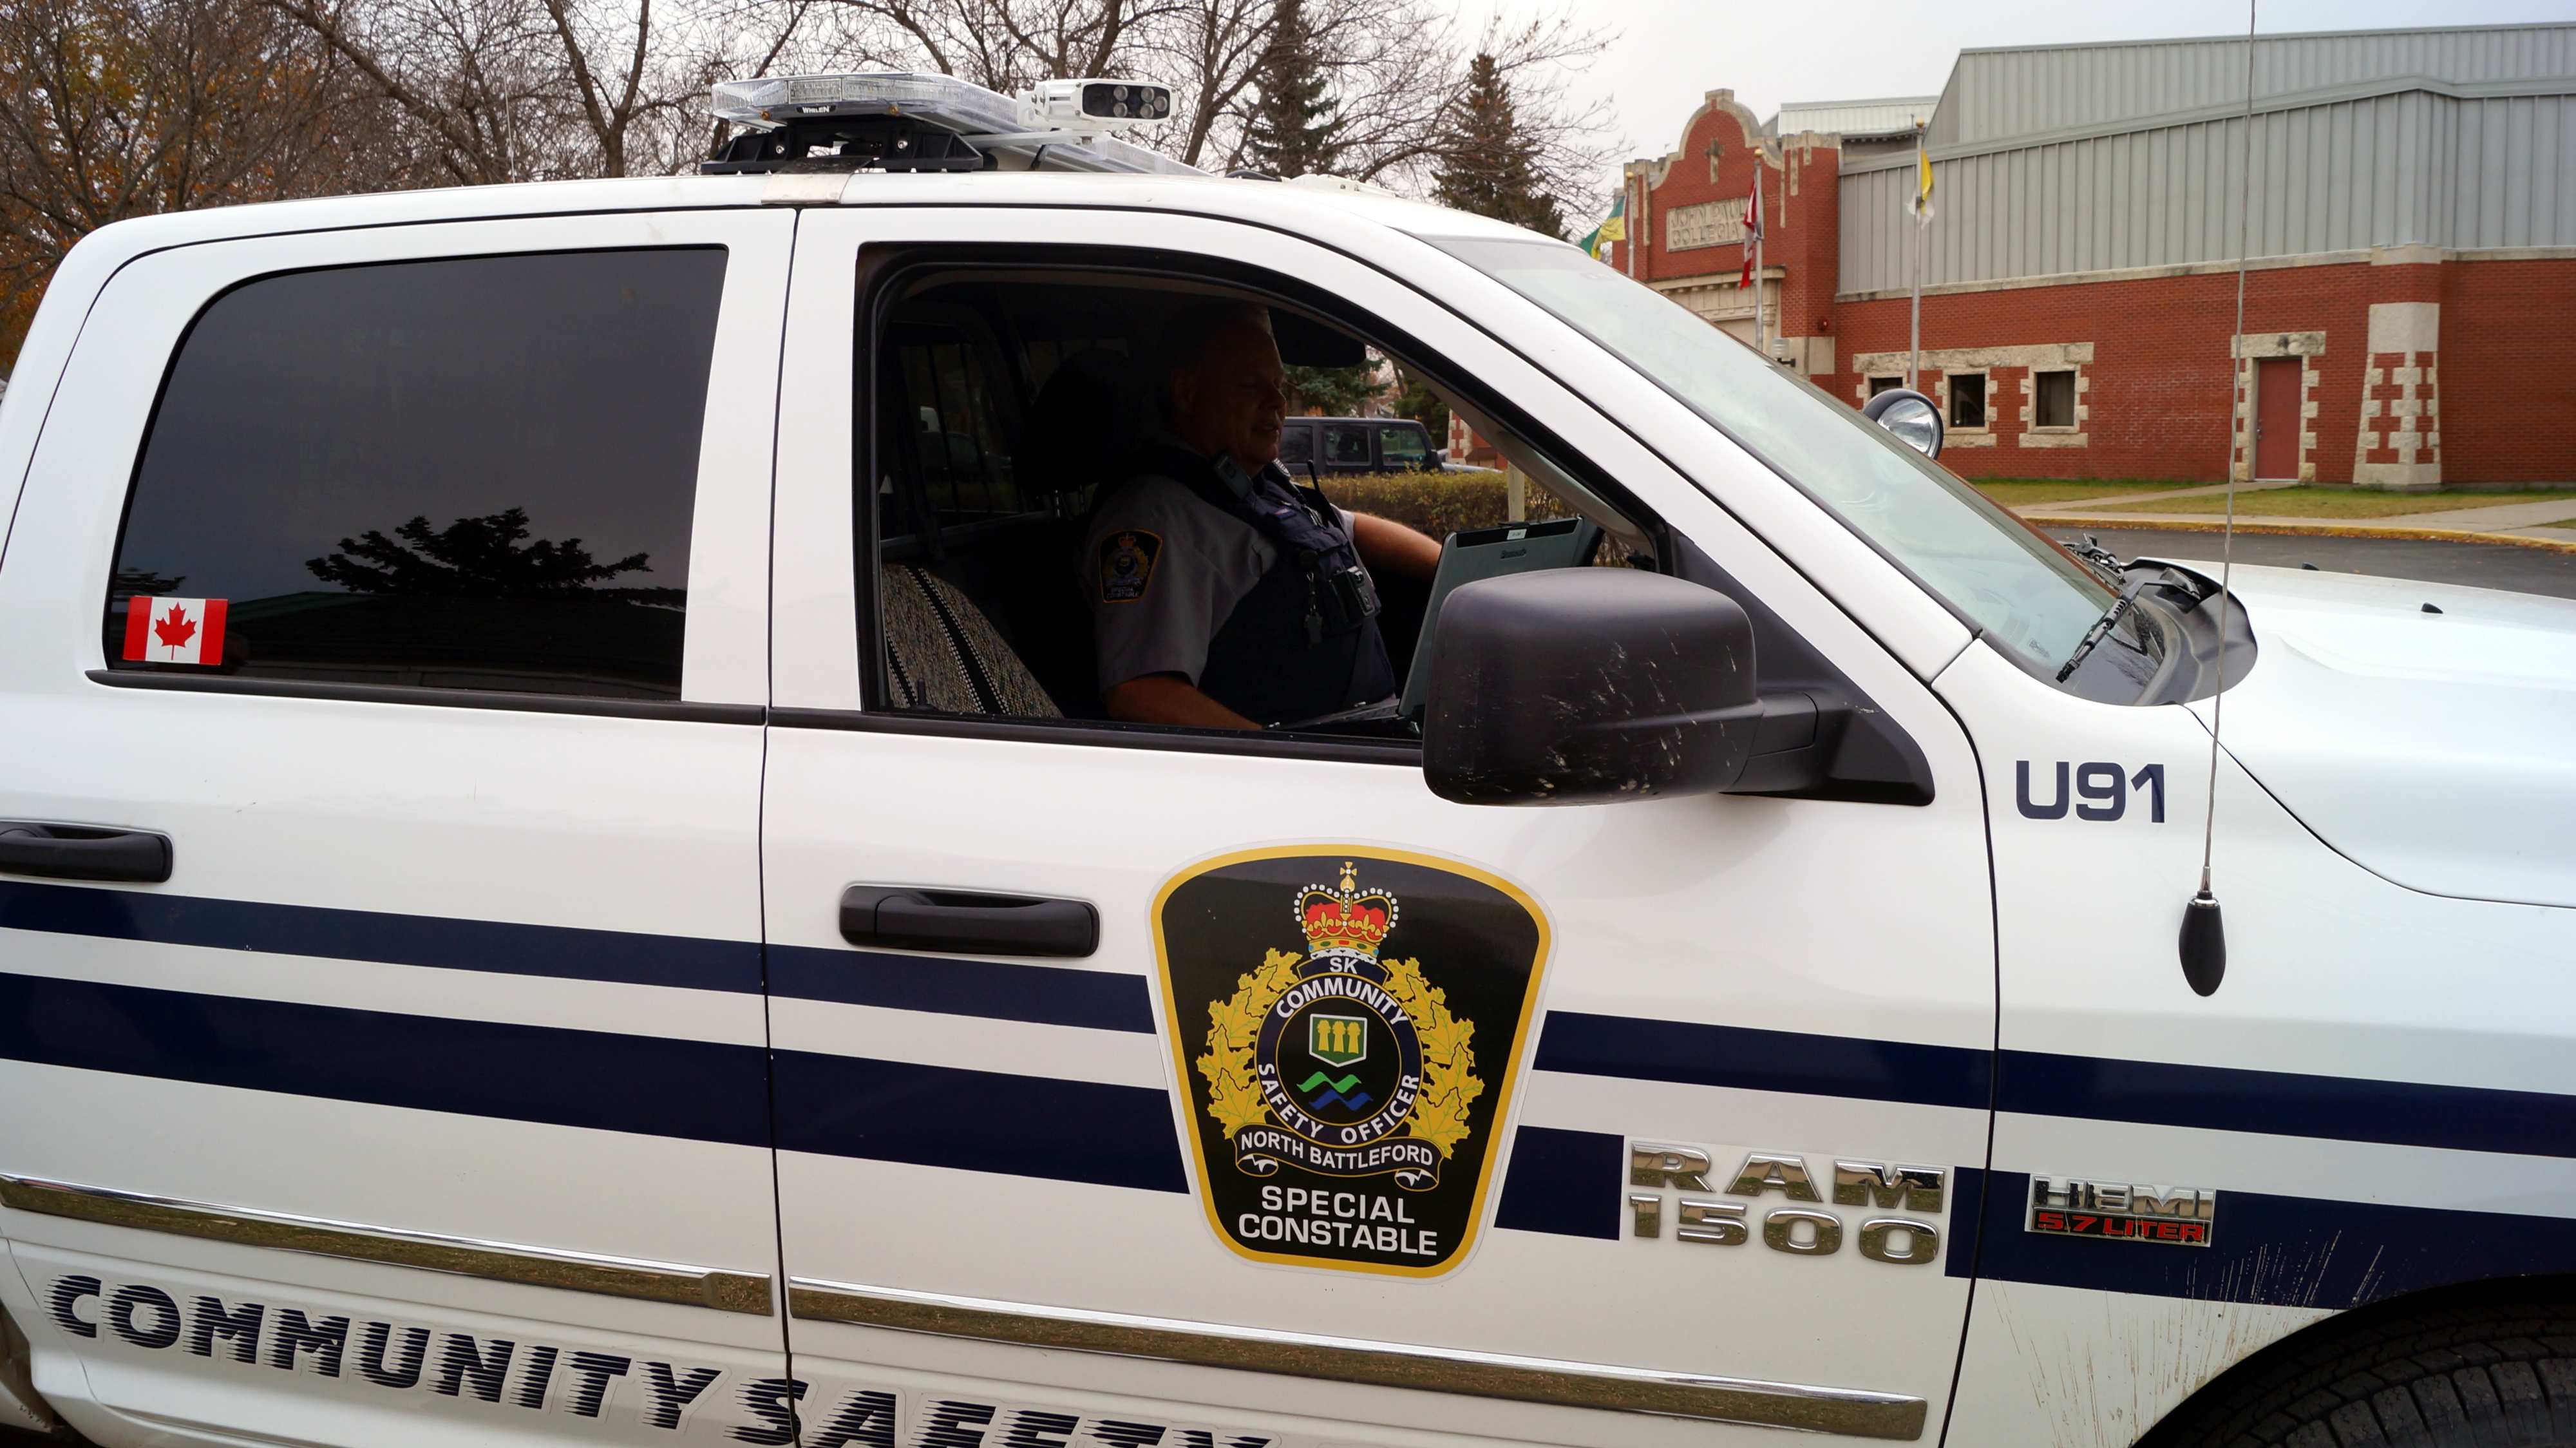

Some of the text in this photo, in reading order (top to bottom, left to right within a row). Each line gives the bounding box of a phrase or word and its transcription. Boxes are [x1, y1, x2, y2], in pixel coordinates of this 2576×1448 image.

[1670, 199, 1747, 227] JOHN PAUL
[1672, 220, 1742, 245] COLLEGIA
[2016, 760, 2164, 823] U91
[1330, 957, 1359, 975] SK
[1276, 977, 1409, 1025] COMMUNITY
[1258, 1063, 1420, 1144] SAFETY OFFICER
[1241, 1131, 1433, 1169] NORTH BATTLEFORD
[1631, 1141, 1946, 1213] RAM
[2033, 1176, 2215, 1219] HEMI
[1262, 1185, 1415, 1223] SPECIAL
[1238, 1214, 1437, 1255] CONSTABLE
[1629, 1193, 1939, 1264] 1500
[2038, 1212, 2204, 1242] 5.7 LITER
[44, 1273, 1273, 1448] COMMUNITY SAFE
